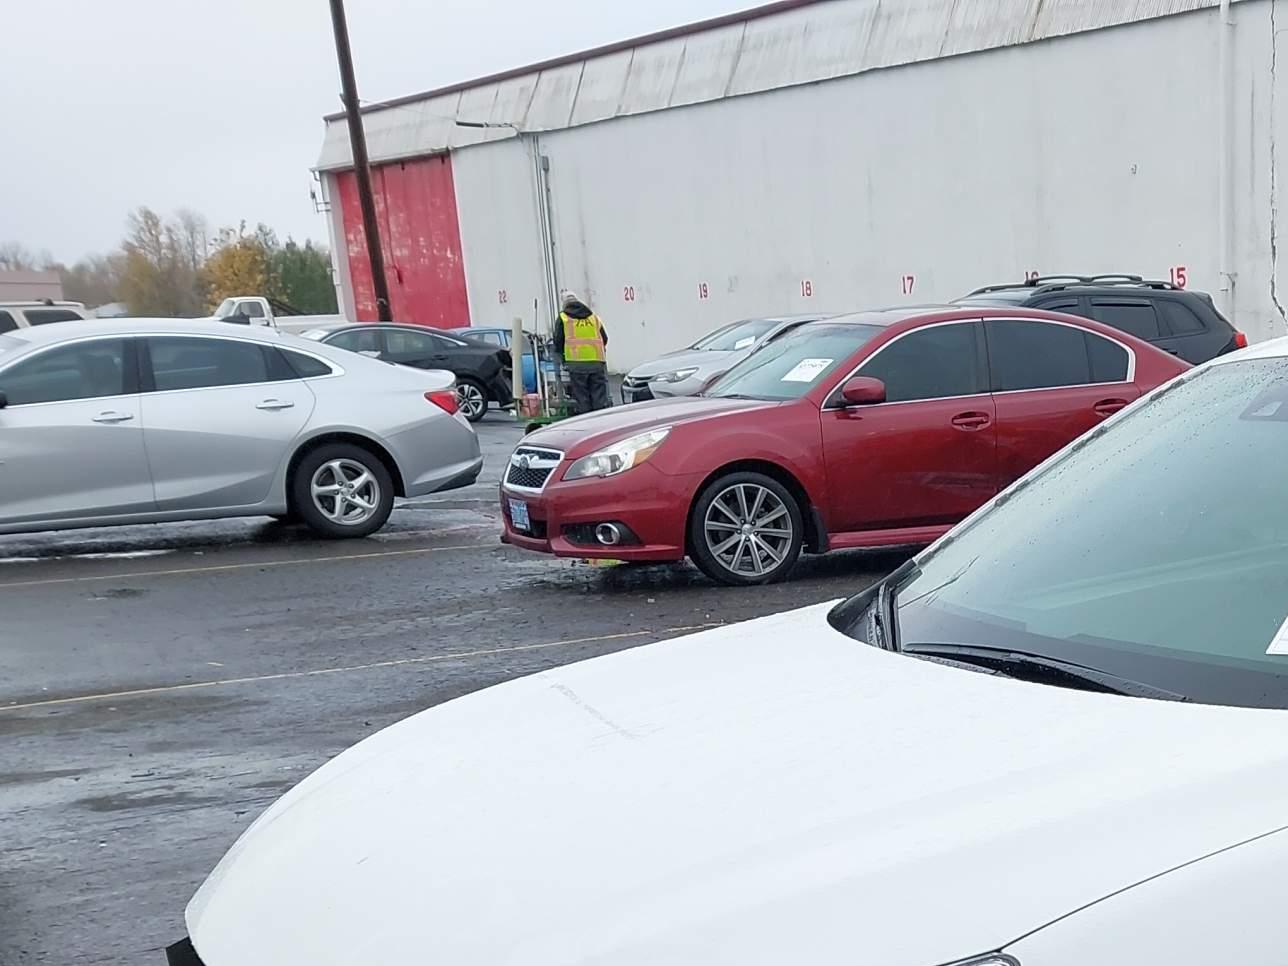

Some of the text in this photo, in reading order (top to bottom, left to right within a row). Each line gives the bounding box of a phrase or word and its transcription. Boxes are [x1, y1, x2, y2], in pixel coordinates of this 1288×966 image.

[902, 276, 915, 295] 17
[1169, 266, 1188, 289] 15
[623, 286, 635, 301] 20
[699, 283, 708, 299] 19
[800, 280, 813, 297] 18
